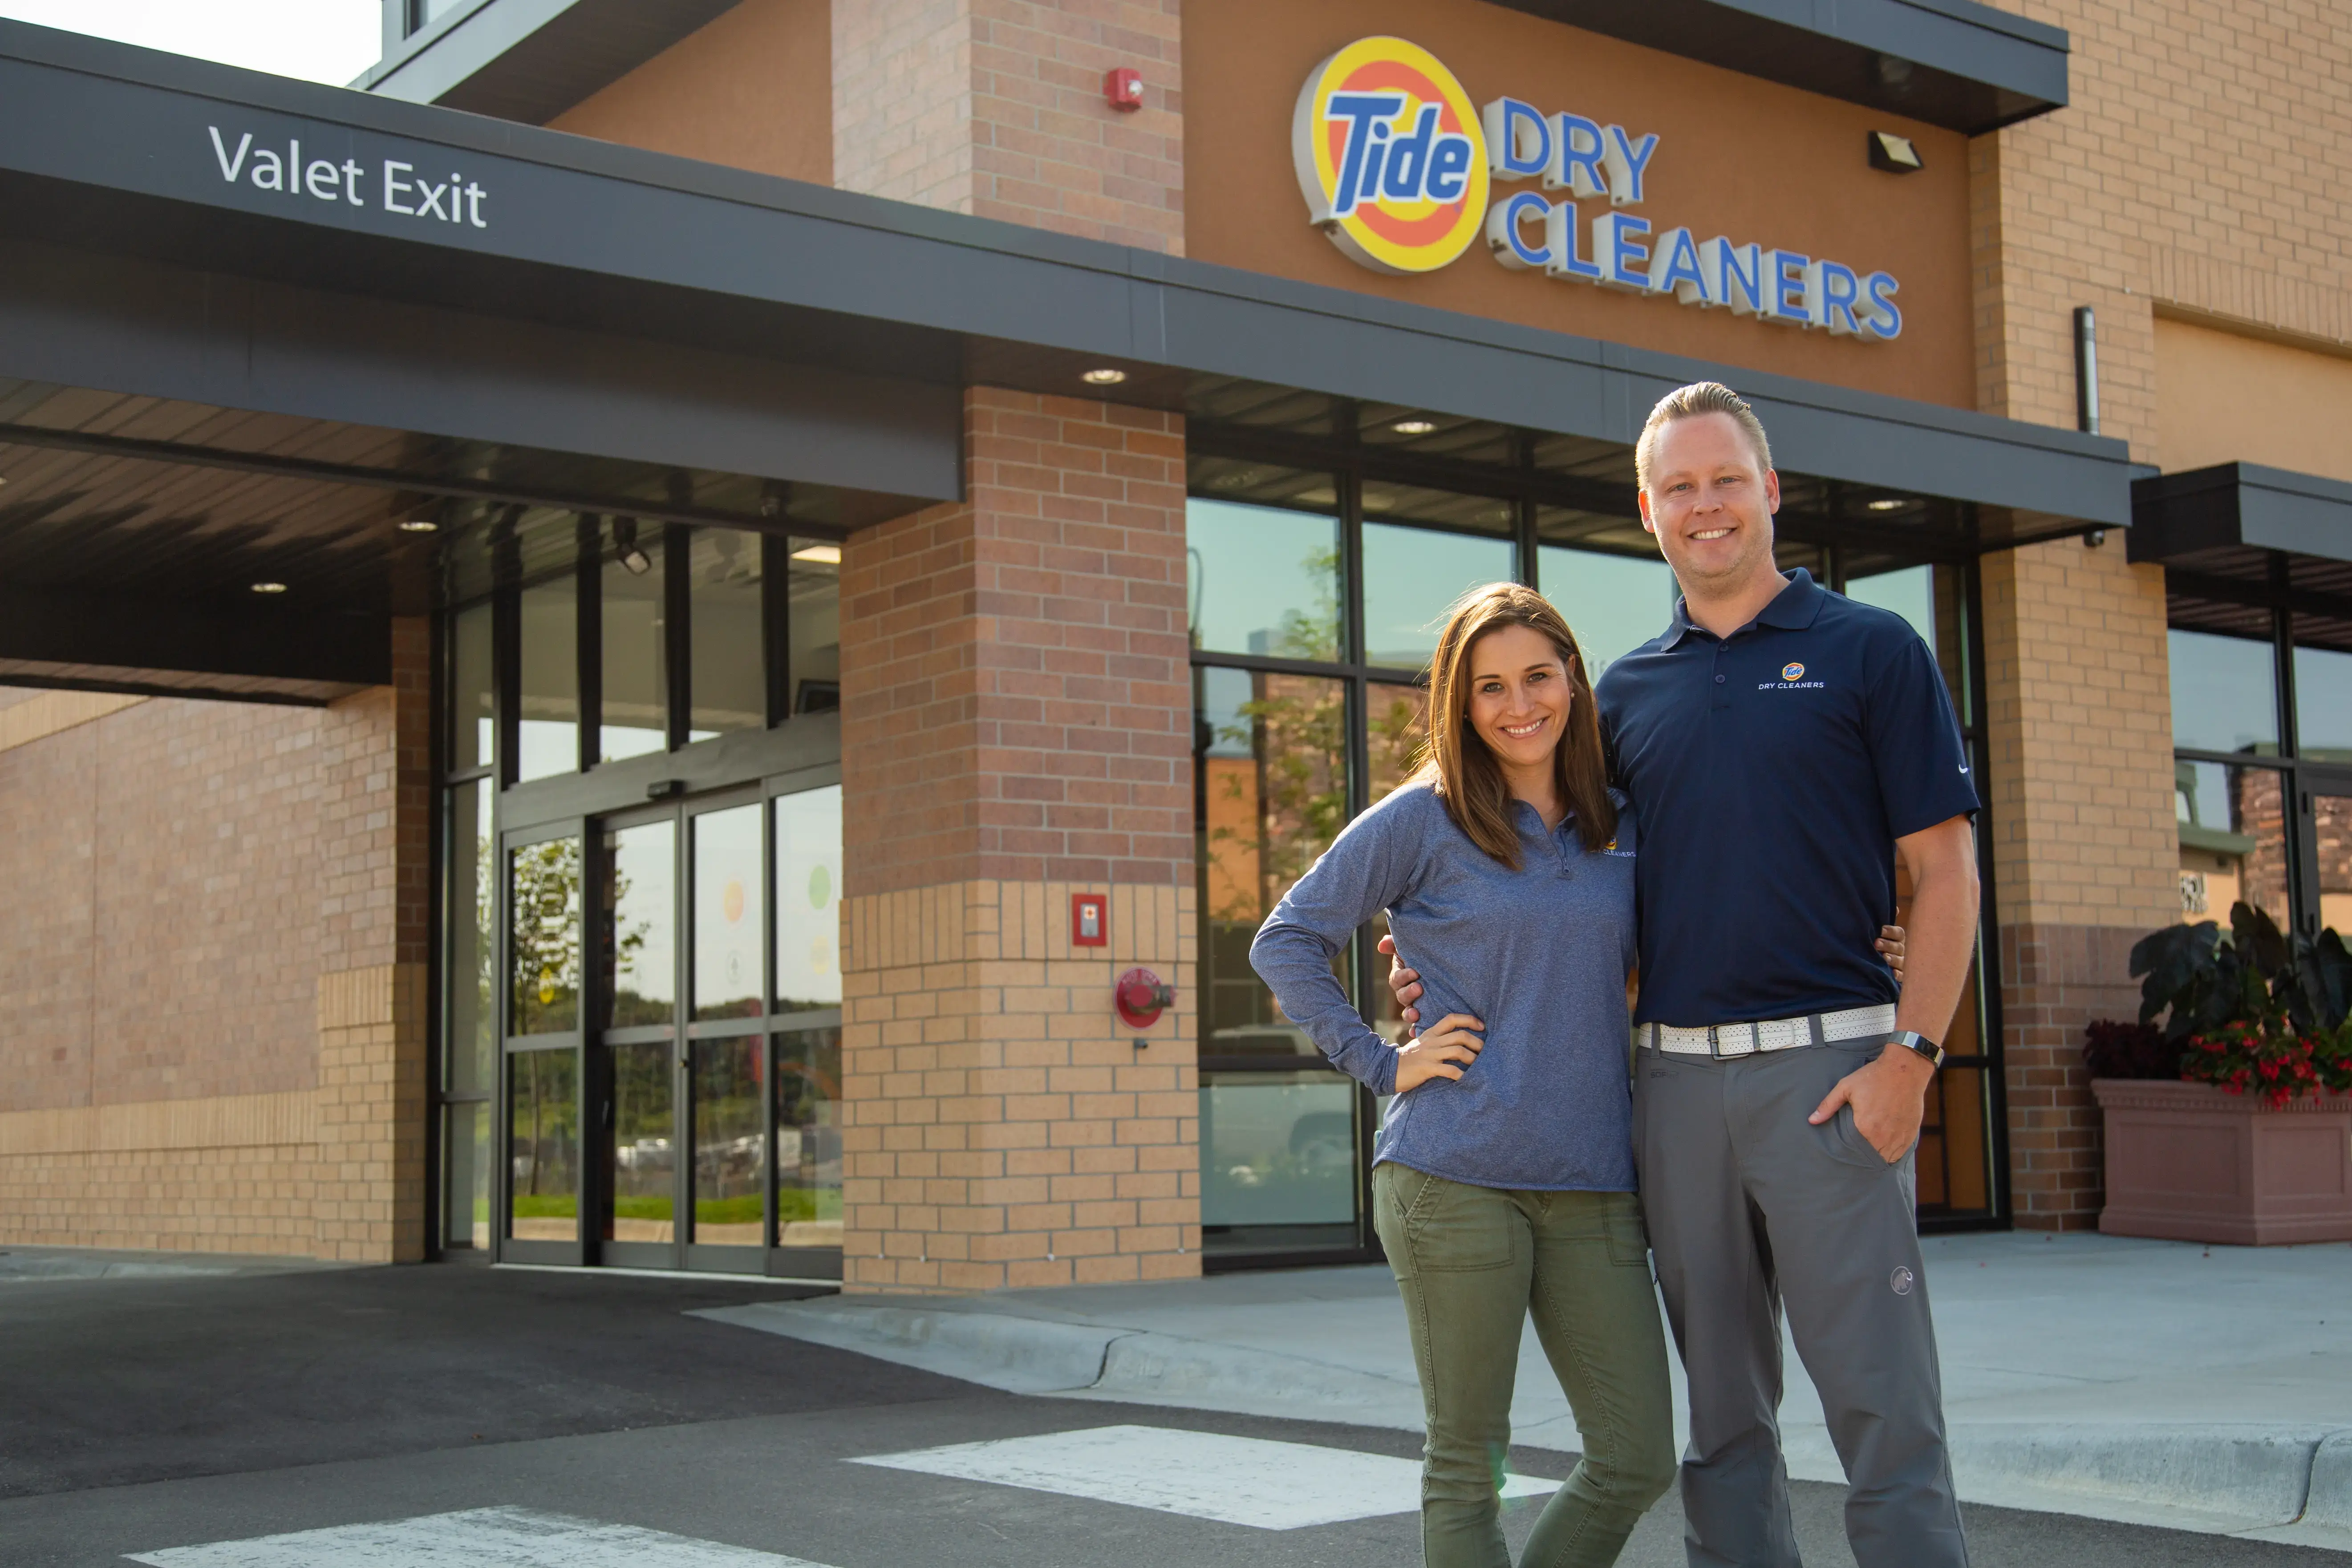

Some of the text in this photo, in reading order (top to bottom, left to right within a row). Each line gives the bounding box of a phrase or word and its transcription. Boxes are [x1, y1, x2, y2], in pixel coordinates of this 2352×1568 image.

[208, 126, 487, 228] Valet Exit
[1325, 91, 1475, 218] Tide
[1500, 96, 1659, 203] DRY
[1504, 191, 1902, 340] CLEANERS
[1783, 666, 1803, 679] Tide
[1603, 849, 1636, 857] CLEANERS
